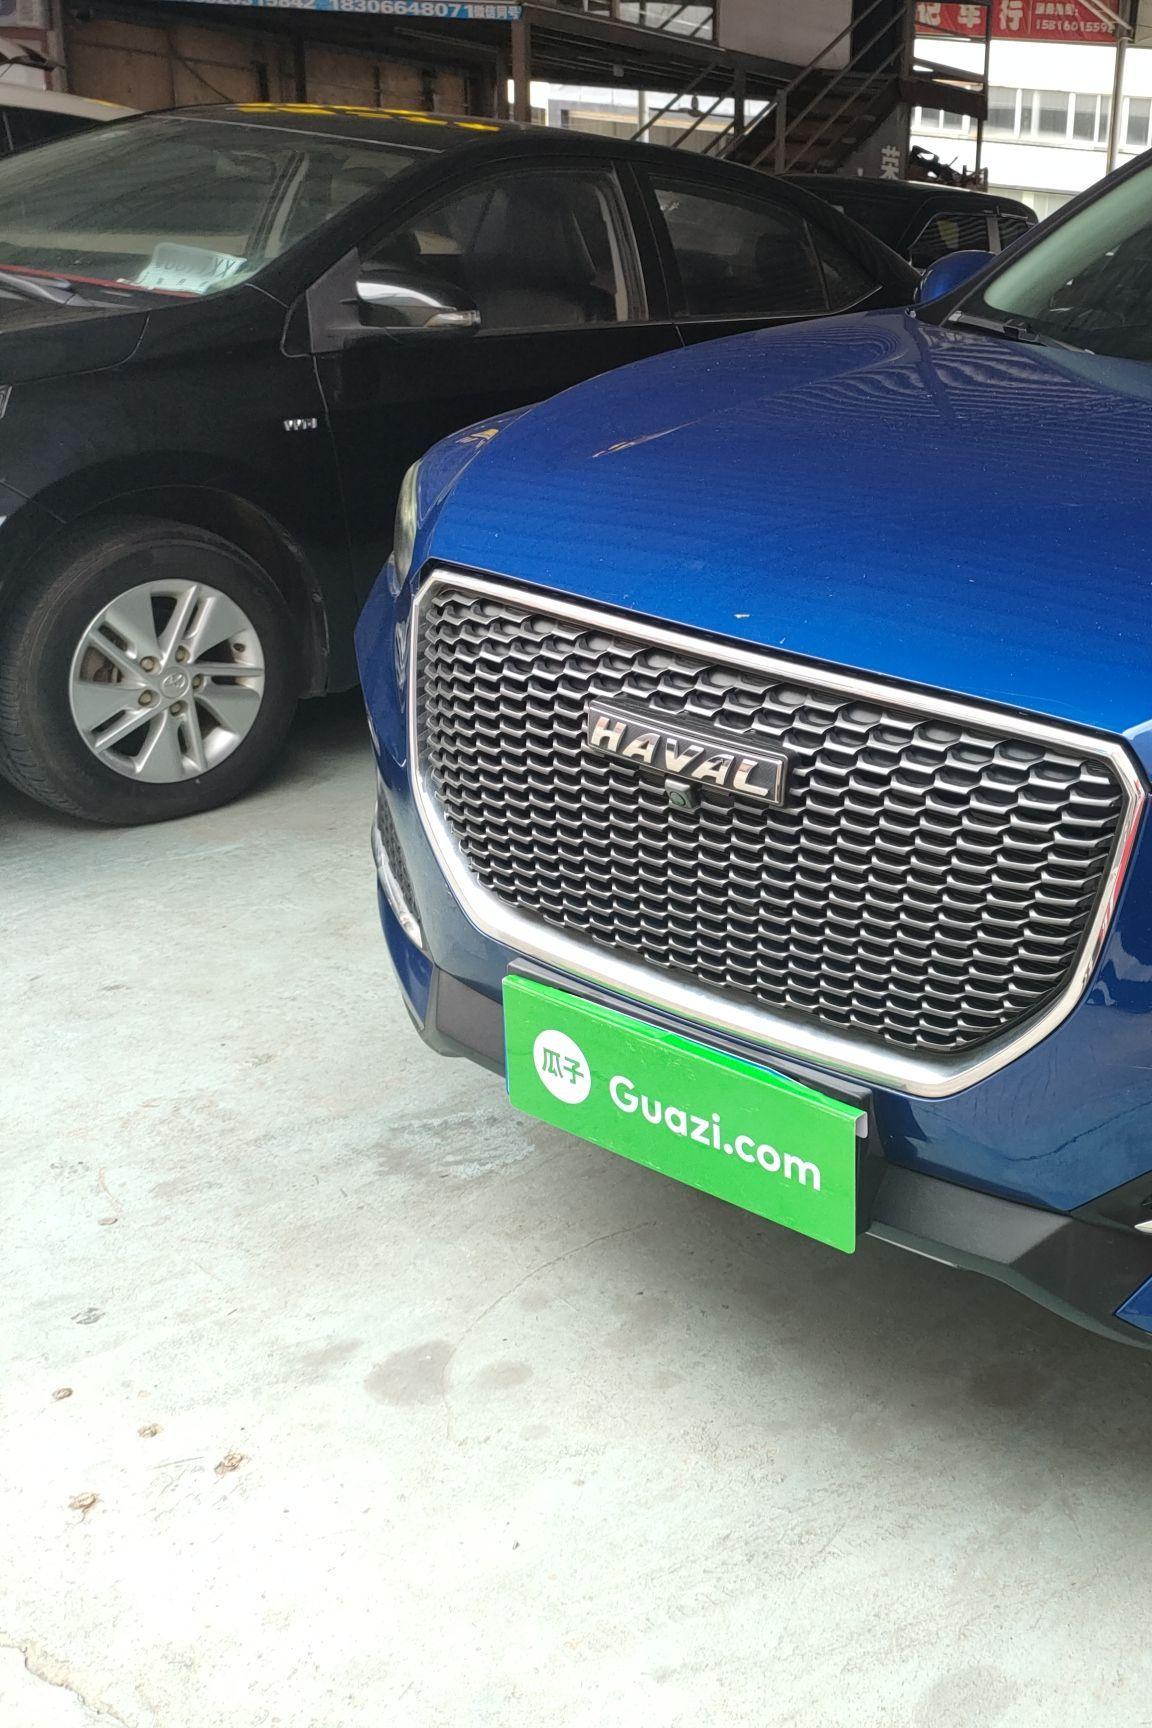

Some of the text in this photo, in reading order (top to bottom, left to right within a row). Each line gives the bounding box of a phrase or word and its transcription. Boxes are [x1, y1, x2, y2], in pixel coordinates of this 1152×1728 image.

[591, 716, 769, 797] HAVAL
[542, 1047, 585, 1085] 瓜子
[609, 1075, 821, 1192] Guazi.com
